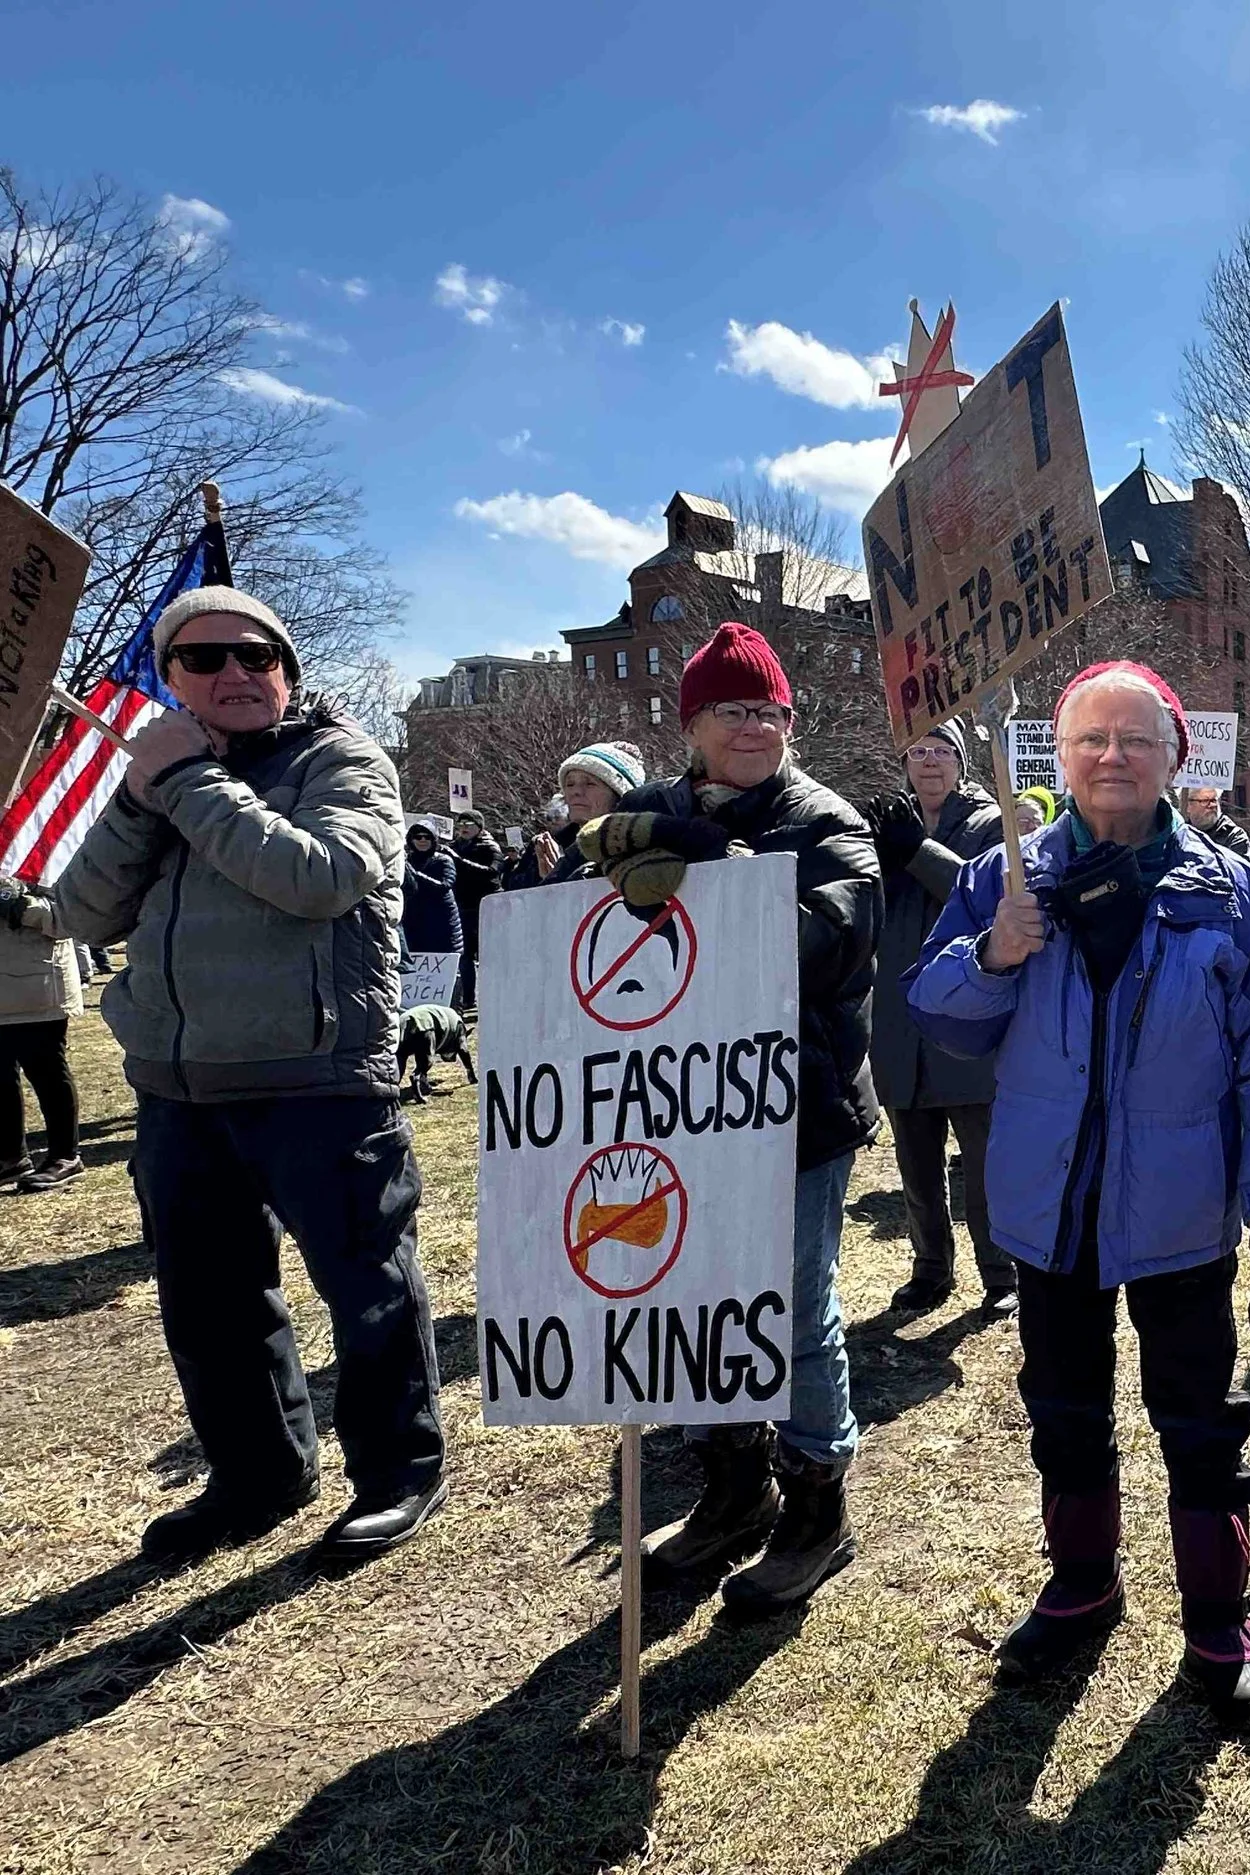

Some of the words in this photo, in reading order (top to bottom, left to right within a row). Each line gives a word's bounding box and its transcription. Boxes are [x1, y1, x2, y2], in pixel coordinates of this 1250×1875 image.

[905, 600, 949, 672] FIT
[959, 566, 992, 621] TO
[1011, 506, 1061, 584] BE
[900, 536, 1094, 736] PRESIDENT
[1016, 733, 1043, 743] STAND
[1016, 745, 1026, 755] TO
[1028, 745, 1056, 755] TRUMP
[1016, 759, 1056, 773] GENERAL
[1181, 758, 1230, 777] ERSONS
[1017, 775, 1056, 790] STRIKE!
[411, 955, 447, 973] TAX
[401, 984, 446, 999] RICH
[485, 1063, 563, 1151] NO
[583, 1029, 798, 1145] FASCISTS
[485, 1315, 573, 1402] NO
[604, 1290, 786, 1404] KINGS
